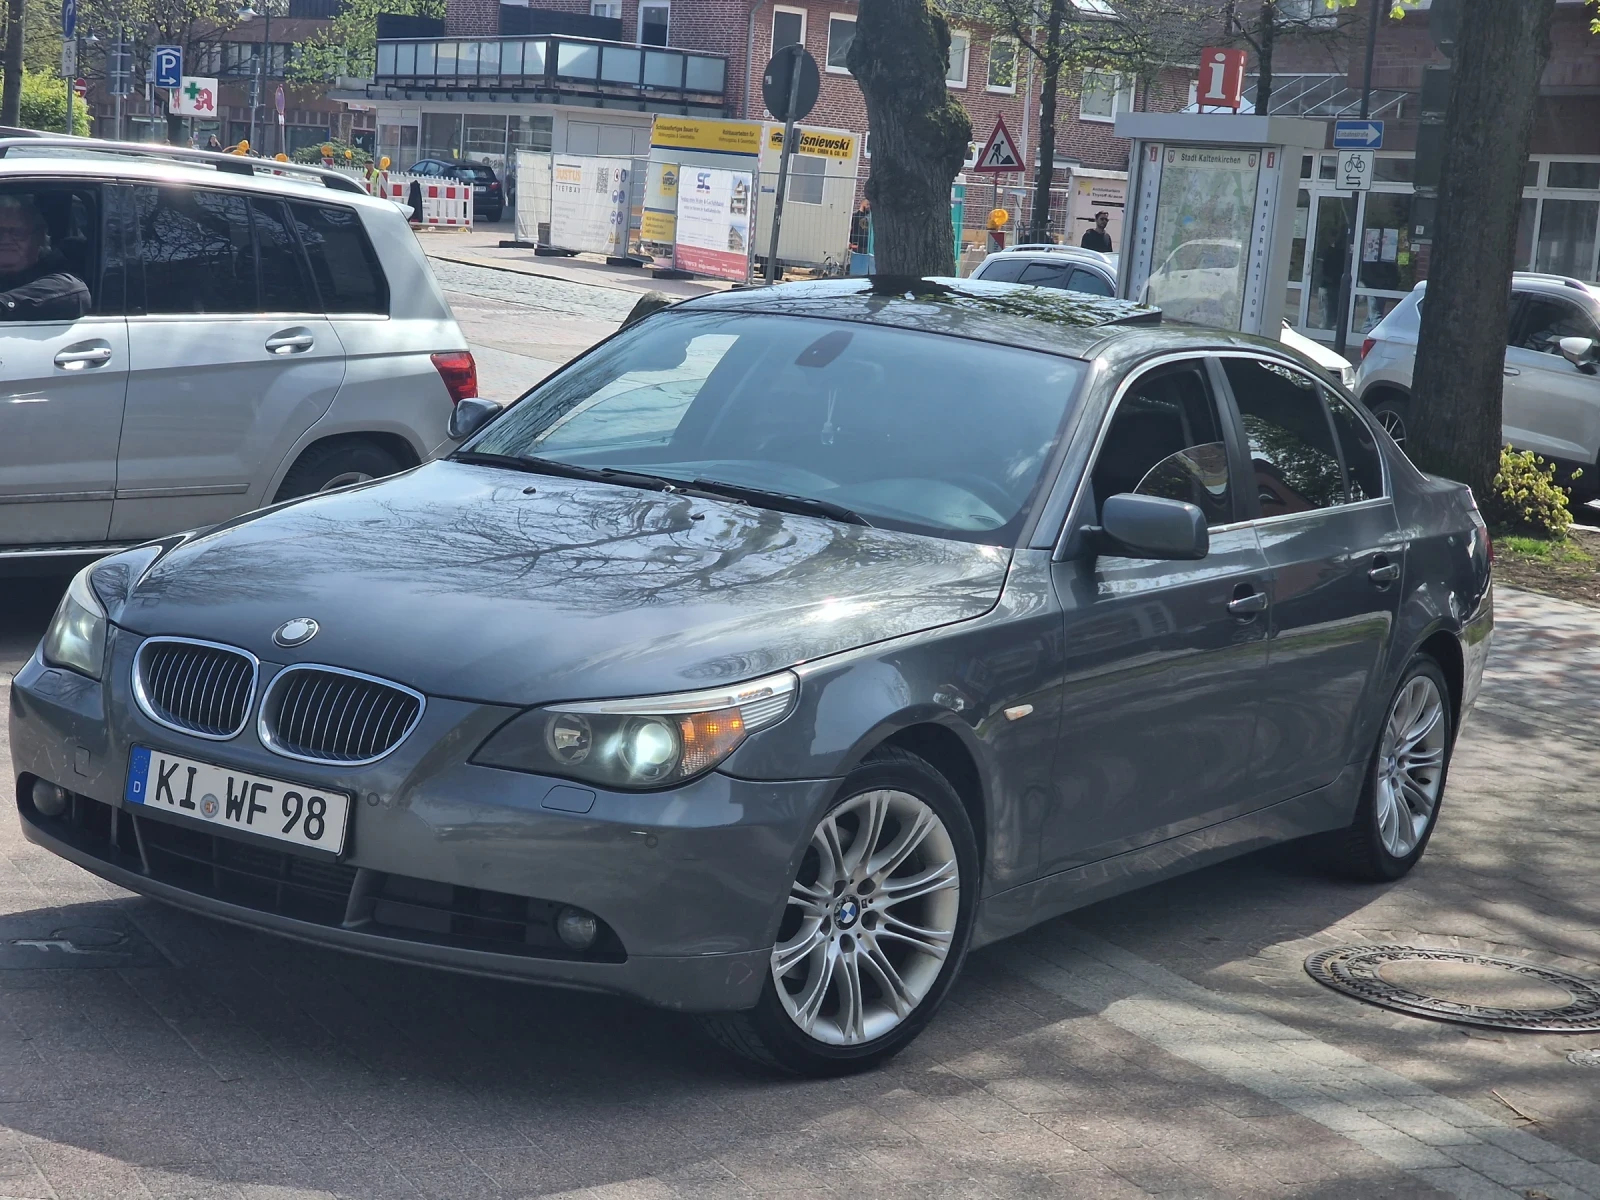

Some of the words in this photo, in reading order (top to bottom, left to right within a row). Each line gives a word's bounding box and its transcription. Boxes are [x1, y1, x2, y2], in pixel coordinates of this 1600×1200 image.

[162, 54, 176, 76] P
[800, 133, 851, 151] isniewski
[1181, 153, 1197, 162] Stadt
[1199, 154, 1241, 164] Kaltenkirchen
[556, 168, 581, 182] JUSTUS
[133, 780, 141, 793] D
[155, 759, 197, 810] KI
[225, 776, 273, 825] WF
[281, 791, 327, 841] 98
